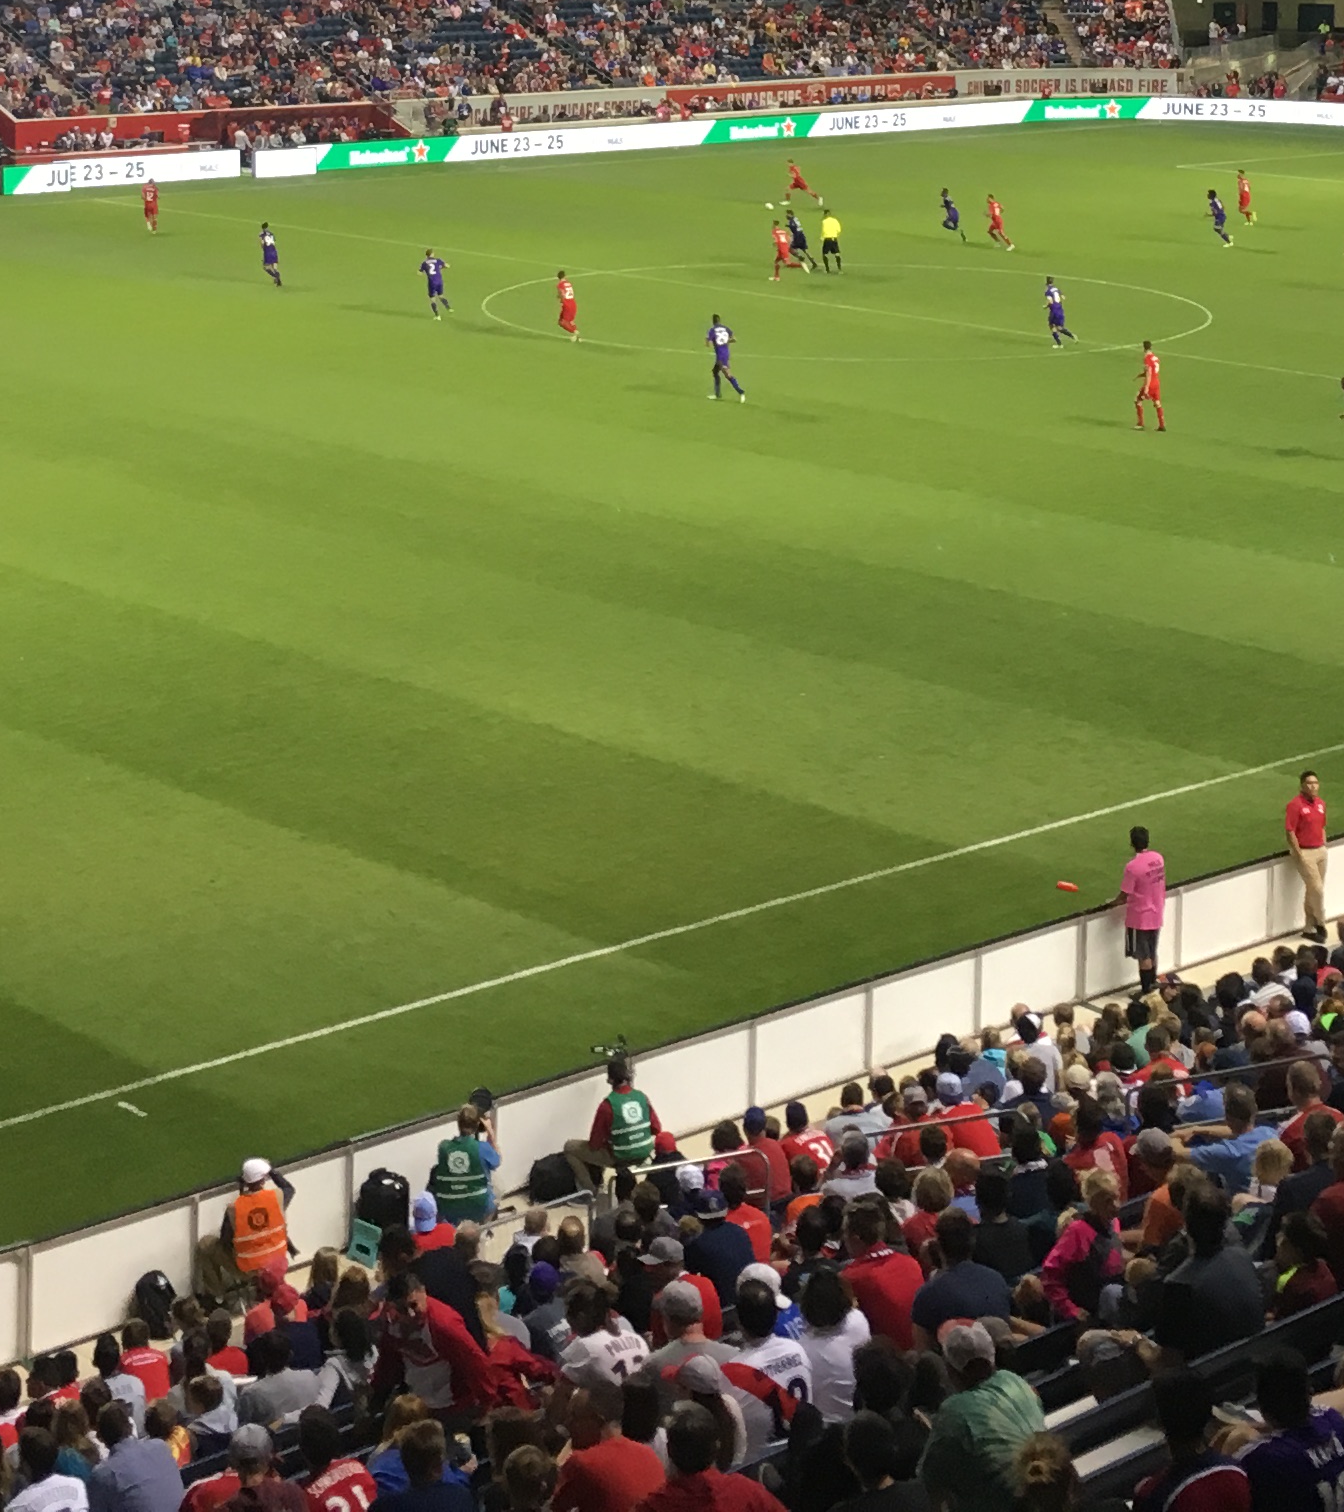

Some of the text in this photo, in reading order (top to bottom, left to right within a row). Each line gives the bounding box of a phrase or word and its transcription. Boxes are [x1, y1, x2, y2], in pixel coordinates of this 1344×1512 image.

[1015, 78, 1060, 93] SOCCER
[1065, 79, 1076, 93] IS
[1139, 79, 1168, 93] FIRE
[1162, 103, 1204, 116] JUNE
[1209, 104, 1229, 116] 23
[1249, 105, 1266, 117] 25
[829, 116, 860, 130] JUNE
[864, 115, 878, 128] 23
[892, 113, 906, 126] 25
[471, 139, 508, 155] JUNE
[513, 138, 530, 152] 23
[548, 135, 564, 149] 25
[84, 165, 104, 180] 23
[125, 162, 145, 178] 25
[429, 263, 436, 274] 2
